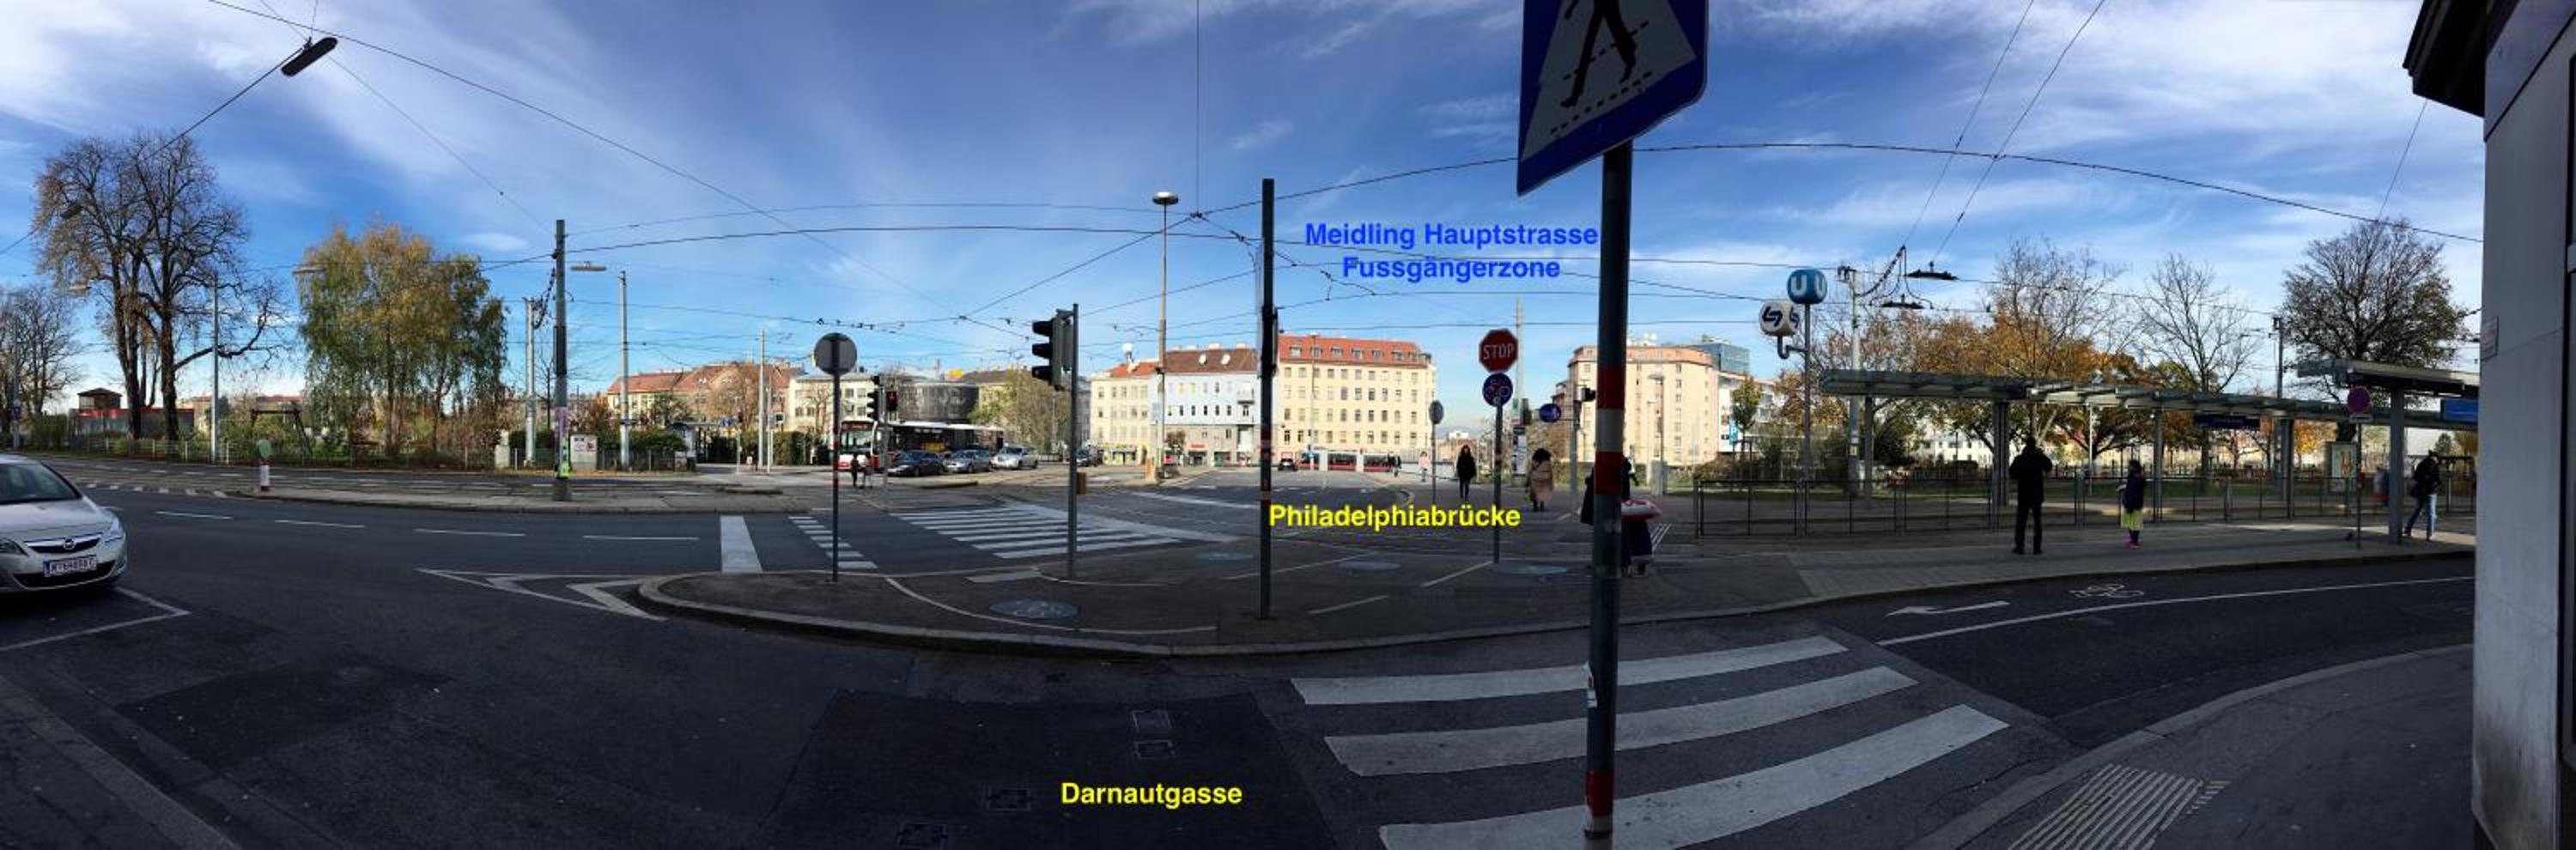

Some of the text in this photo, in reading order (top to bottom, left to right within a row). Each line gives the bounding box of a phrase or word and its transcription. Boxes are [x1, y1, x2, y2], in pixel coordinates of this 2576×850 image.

[1790, 274, 1807, 296] U
[1814, 274, 1826, 299] U
[1483, 344, 1514, 360] STOP
